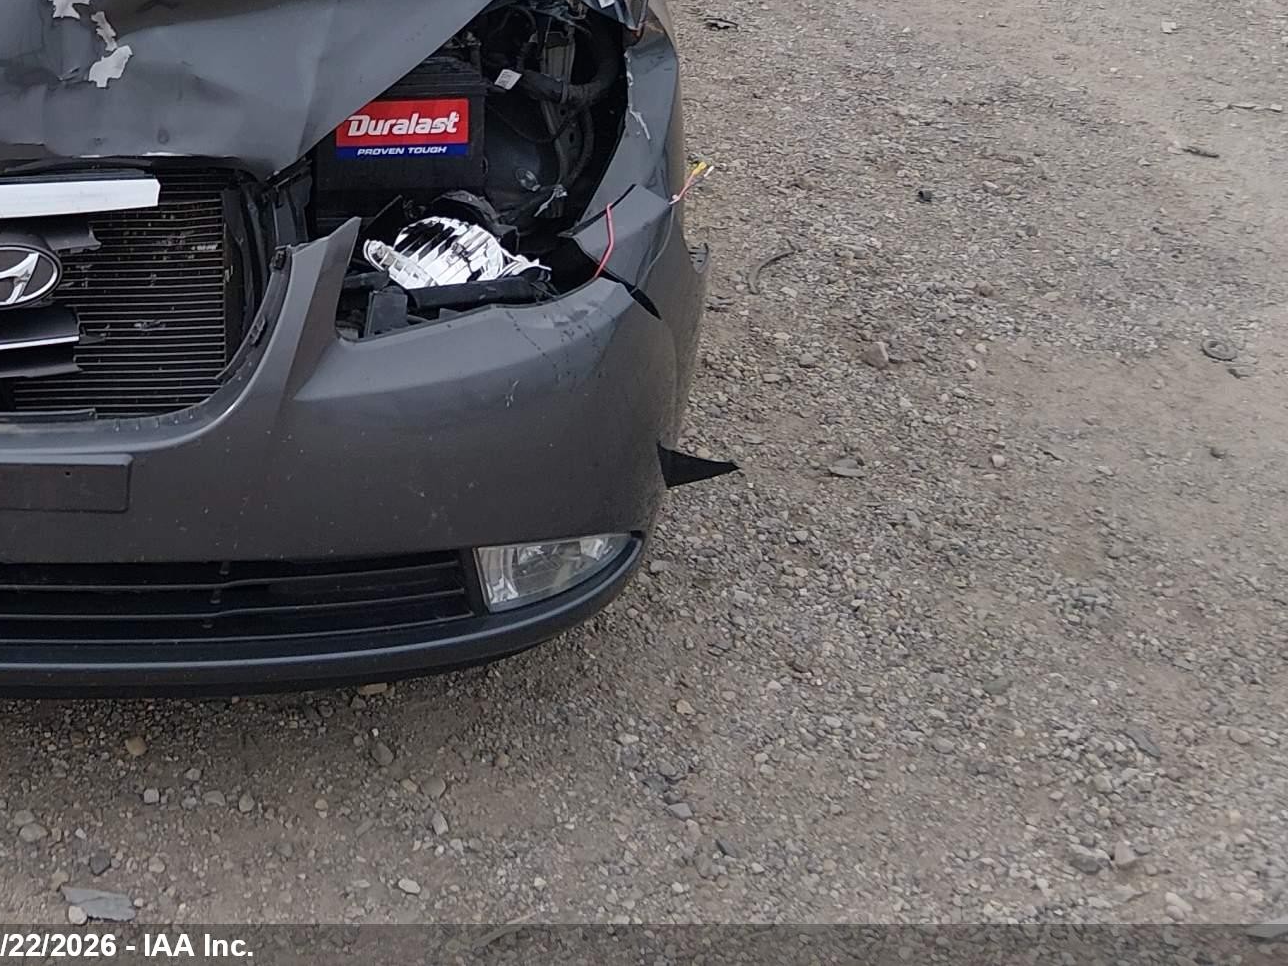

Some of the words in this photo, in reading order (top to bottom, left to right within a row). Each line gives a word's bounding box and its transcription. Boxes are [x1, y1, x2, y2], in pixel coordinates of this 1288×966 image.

[347, 111, 460, 137] Duralast
[357, 147, 405, 156] PROVEN
[408, 146, 447, 155] TOUGH
